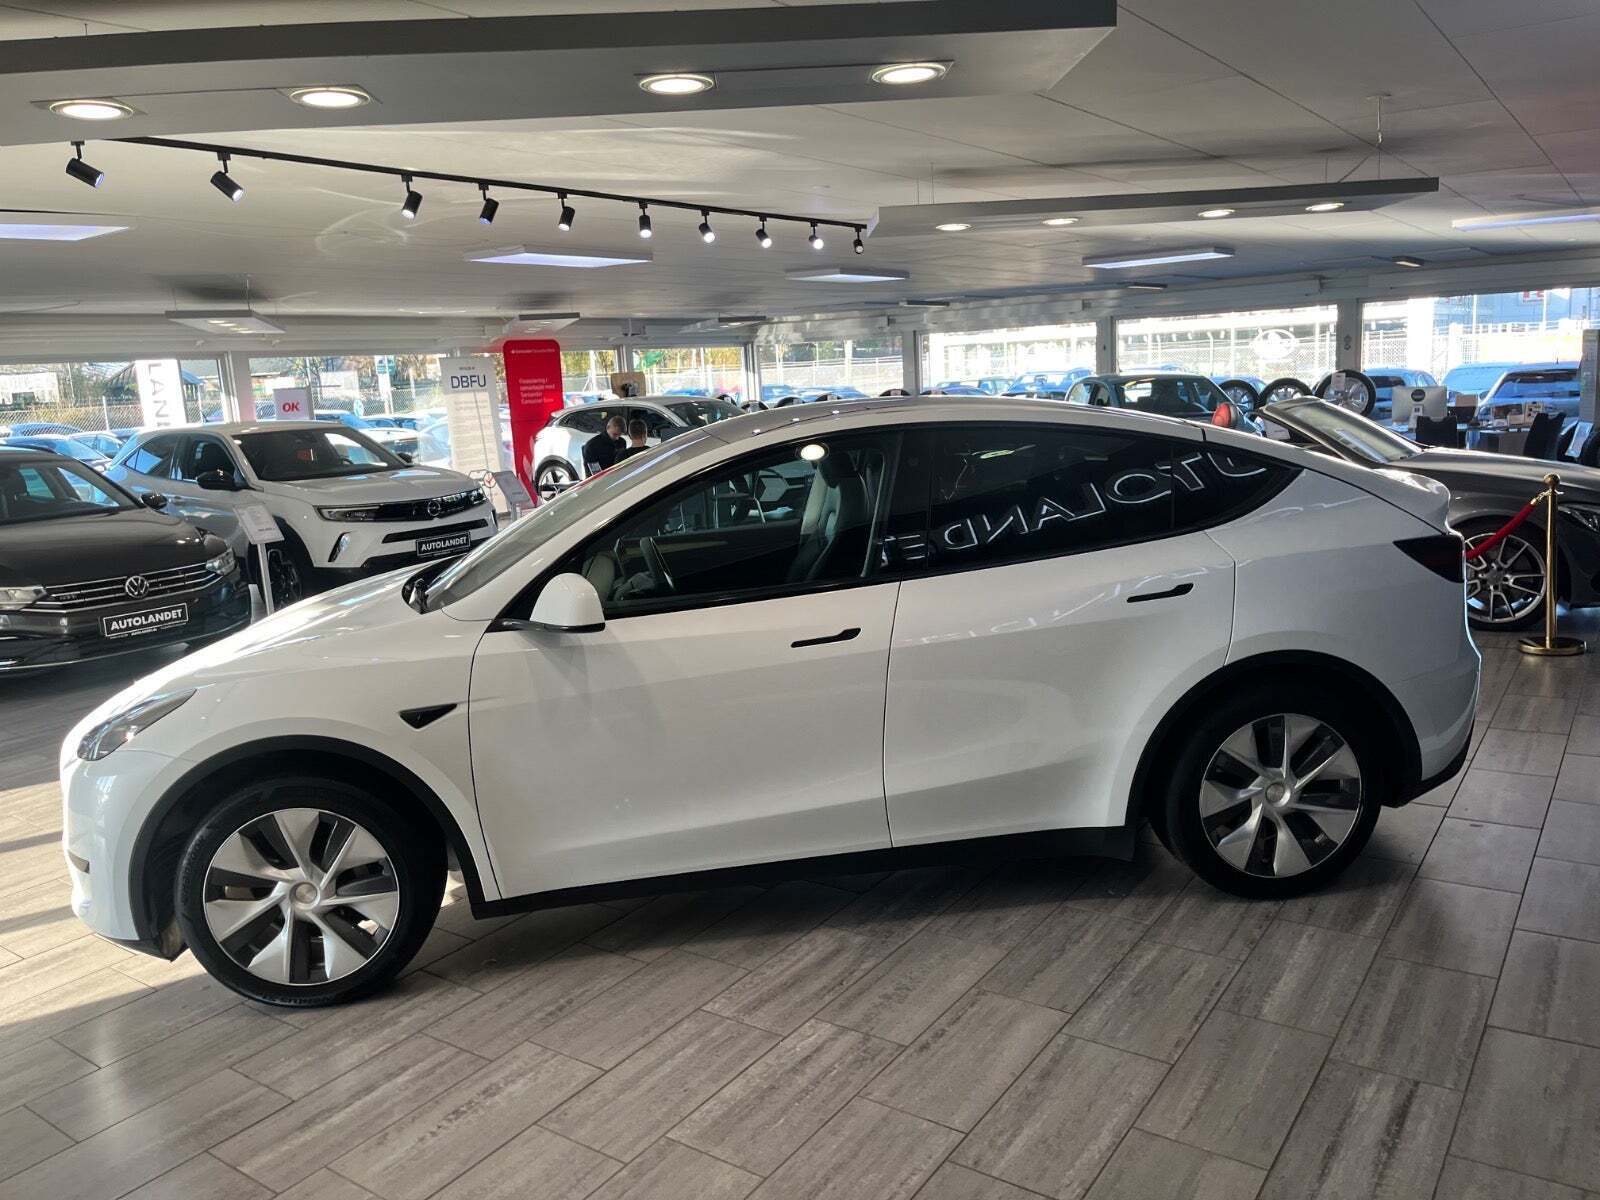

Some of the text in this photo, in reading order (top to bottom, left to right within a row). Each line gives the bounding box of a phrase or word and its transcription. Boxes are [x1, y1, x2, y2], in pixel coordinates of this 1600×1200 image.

[450, 374, 487, 389] DBFU
[282, 401, 300, 413] OK
[421, 536, 467, 551] AUTOLANDET
[110, 608, 183, 631] AUTOLANDET
